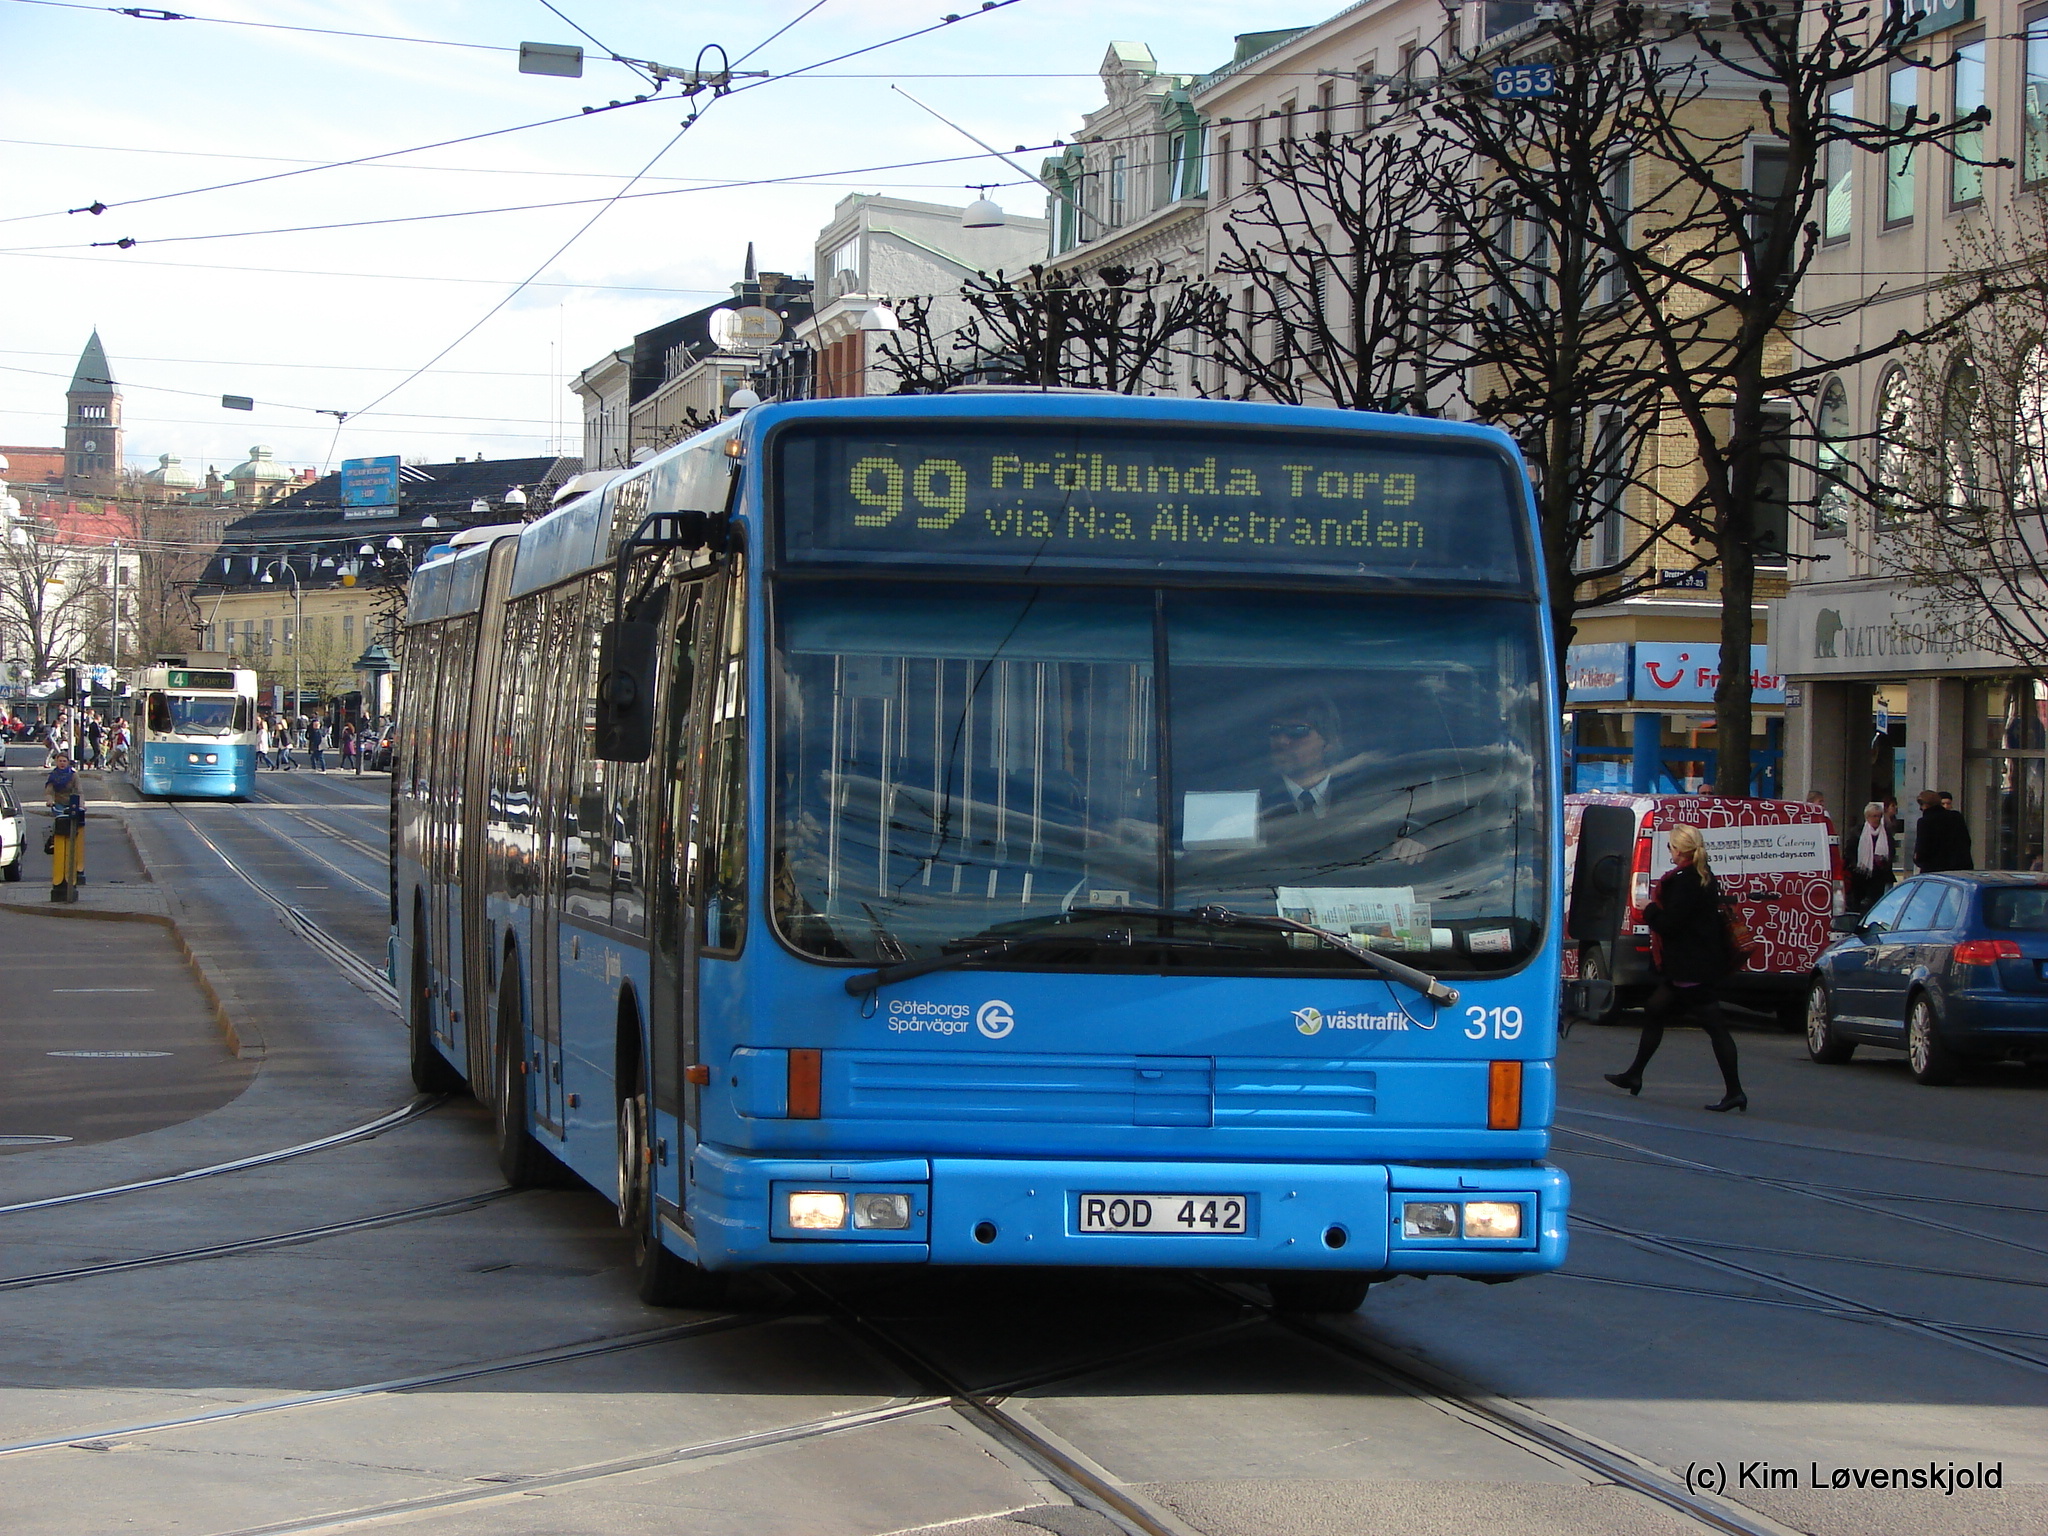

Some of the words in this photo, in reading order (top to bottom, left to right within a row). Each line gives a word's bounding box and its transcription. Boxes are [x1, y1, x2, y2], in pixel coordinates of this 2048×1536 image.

[1496, 68, 1552, 95] 653
[990, 452, 1262, 496] Frölunda
[1281, 464, 1416, 506] Torg
[850, 457, 967, 529] 99
[984, 498, 1053, 538] via
[1067, 505, 1137, 540] N:a
[1150, 502, 1424, 548] Älvstranden
[173, 672, 184, 686] 4
[1776, 834, 1816, 848] Catering
[1728, 851, 1816, 861] www.golden-days.com
[1414, 917, 1427, 926] 12
[888, 999, 971, 1019] Göteborgs
[887, 1015, 970, 1036] Spårvägar
[1326, 1010, 1410, 1032] västtrafik
[1463, 1005, 1524, 1040] 319
[1087, 1198, 1152, 1228] ROD
[1177, 1200, 1242, 1229] 442
